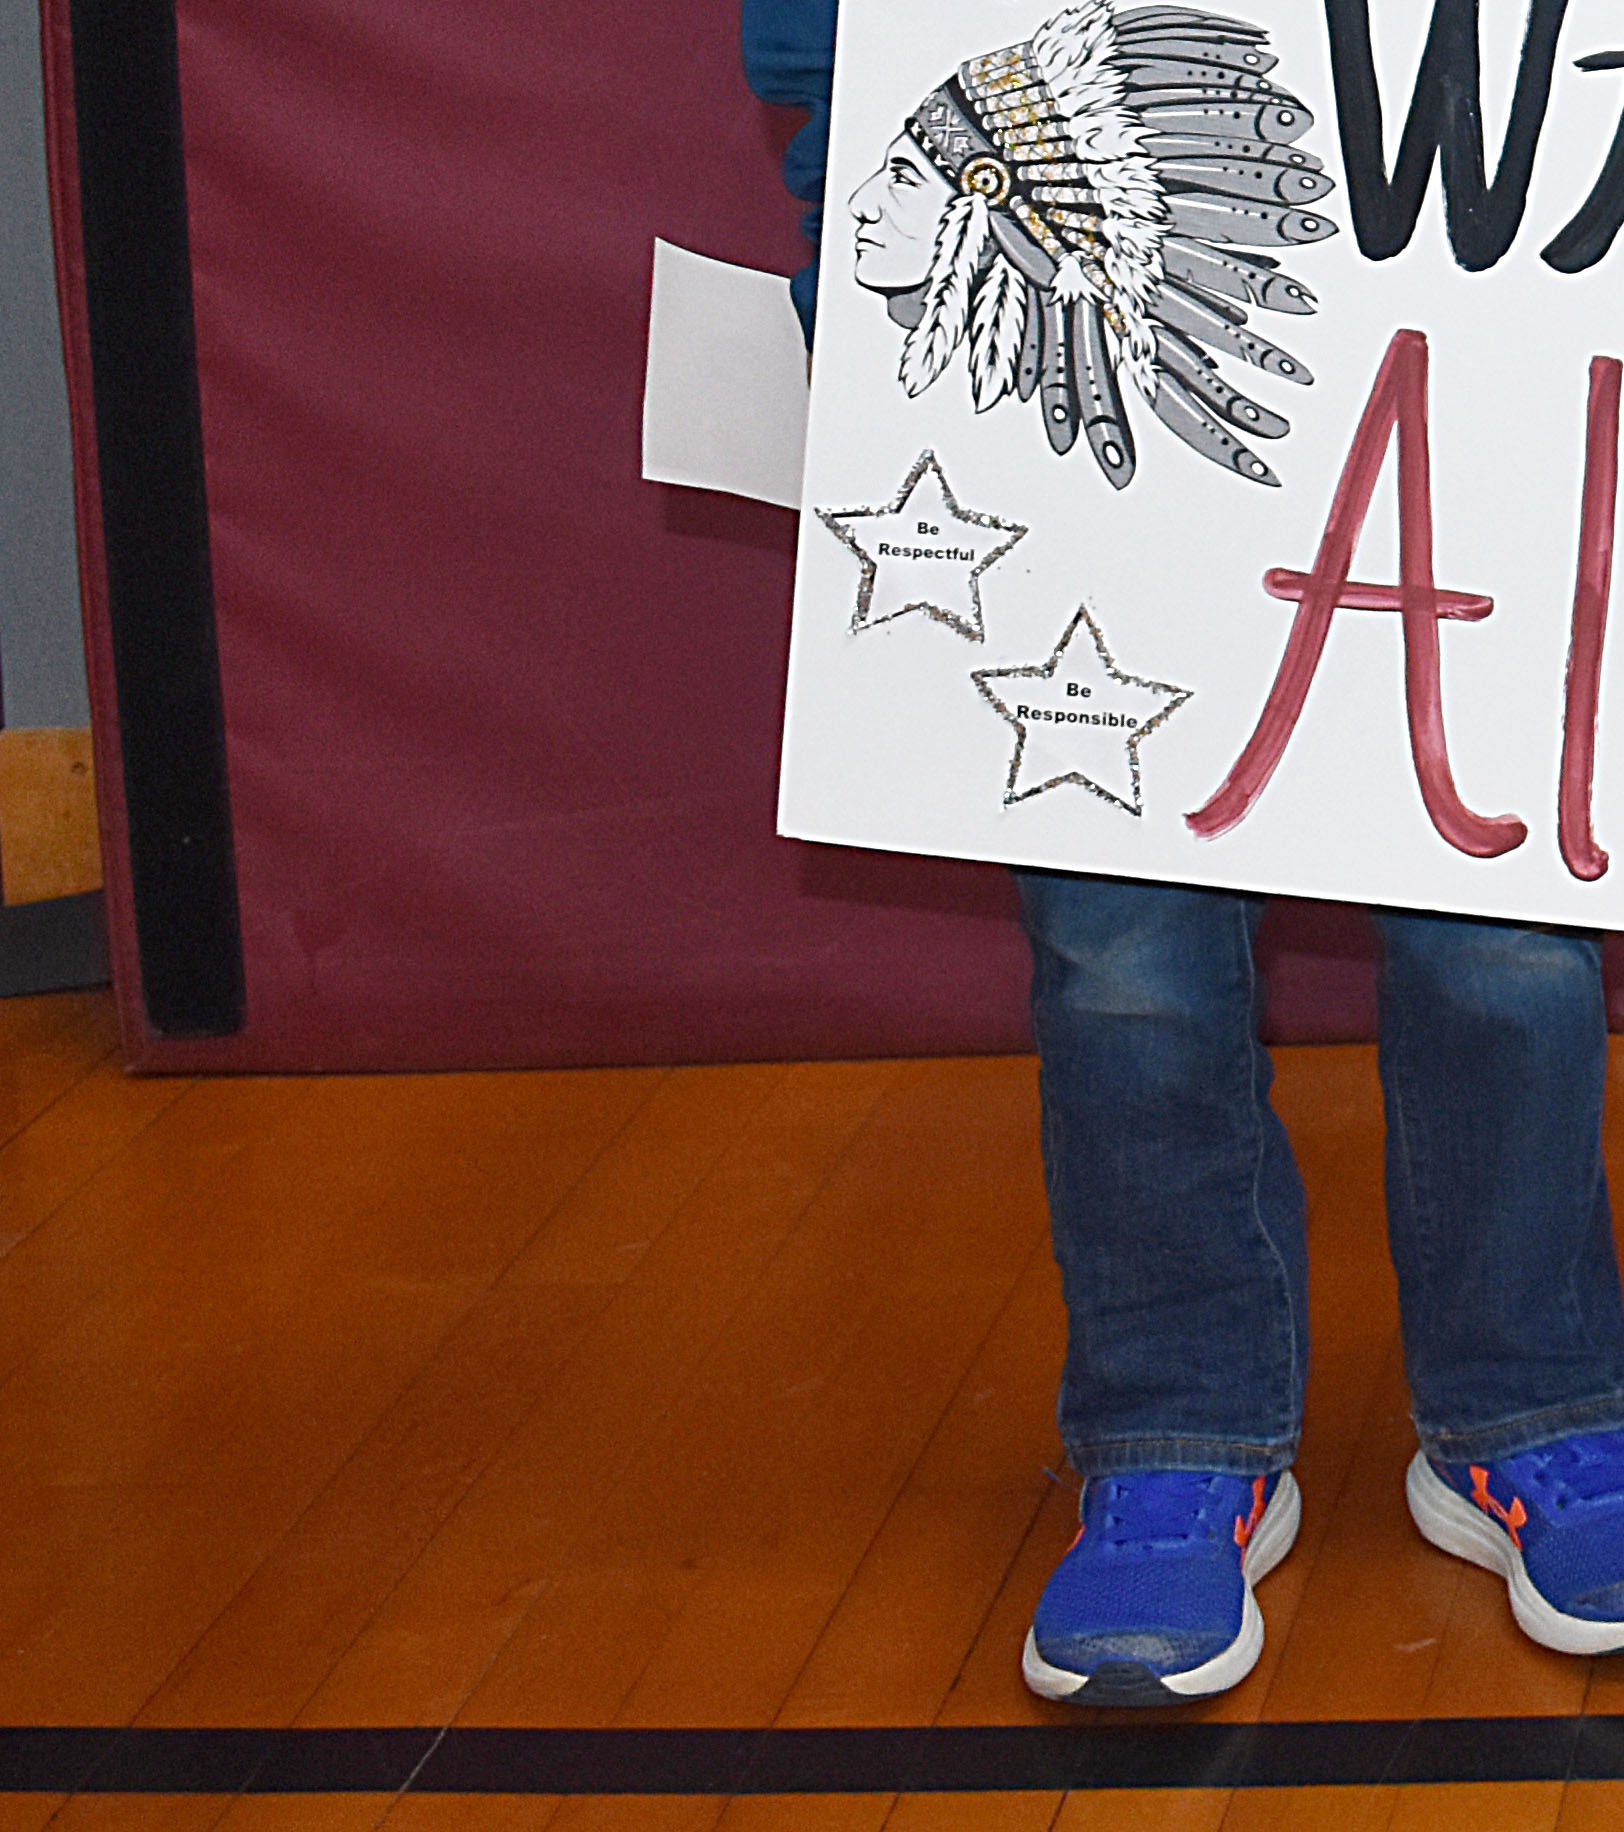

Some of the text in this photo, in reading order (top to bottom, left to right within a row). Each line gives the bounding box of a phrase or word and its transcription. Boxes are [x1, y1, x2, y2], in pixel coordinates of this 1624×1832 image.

[917, 521, 940, 536] Be
[878, 542, 975, 562] Respectful
[1066, 682, 1092, 698] Be
[1017, 704, 1138, 729] Responsible
